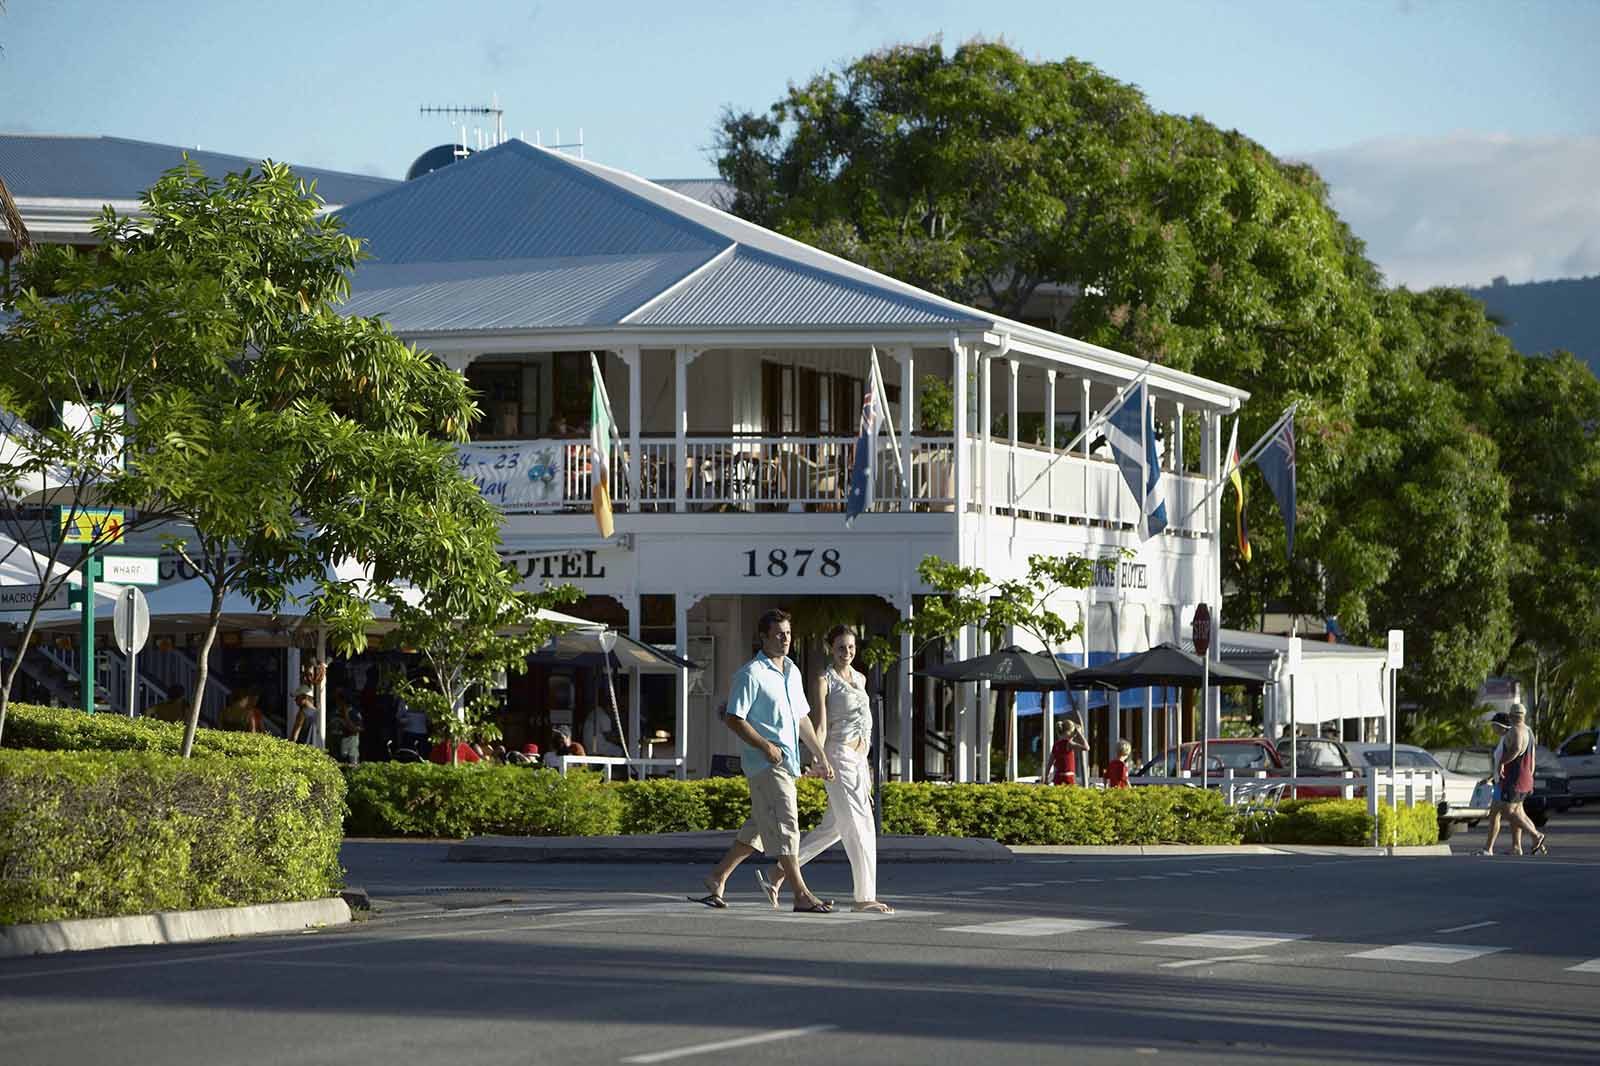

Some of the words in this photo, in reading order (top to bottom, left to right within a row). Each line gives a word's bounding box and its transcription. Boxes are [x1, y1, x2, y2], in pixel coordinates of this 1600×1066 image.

[494, 452, 520, 469] 23
[113, 565, 141, 575] WHARF
[742, 548, 841, 577] 1878
[1121, 562, 1147, 589] HOTEL
